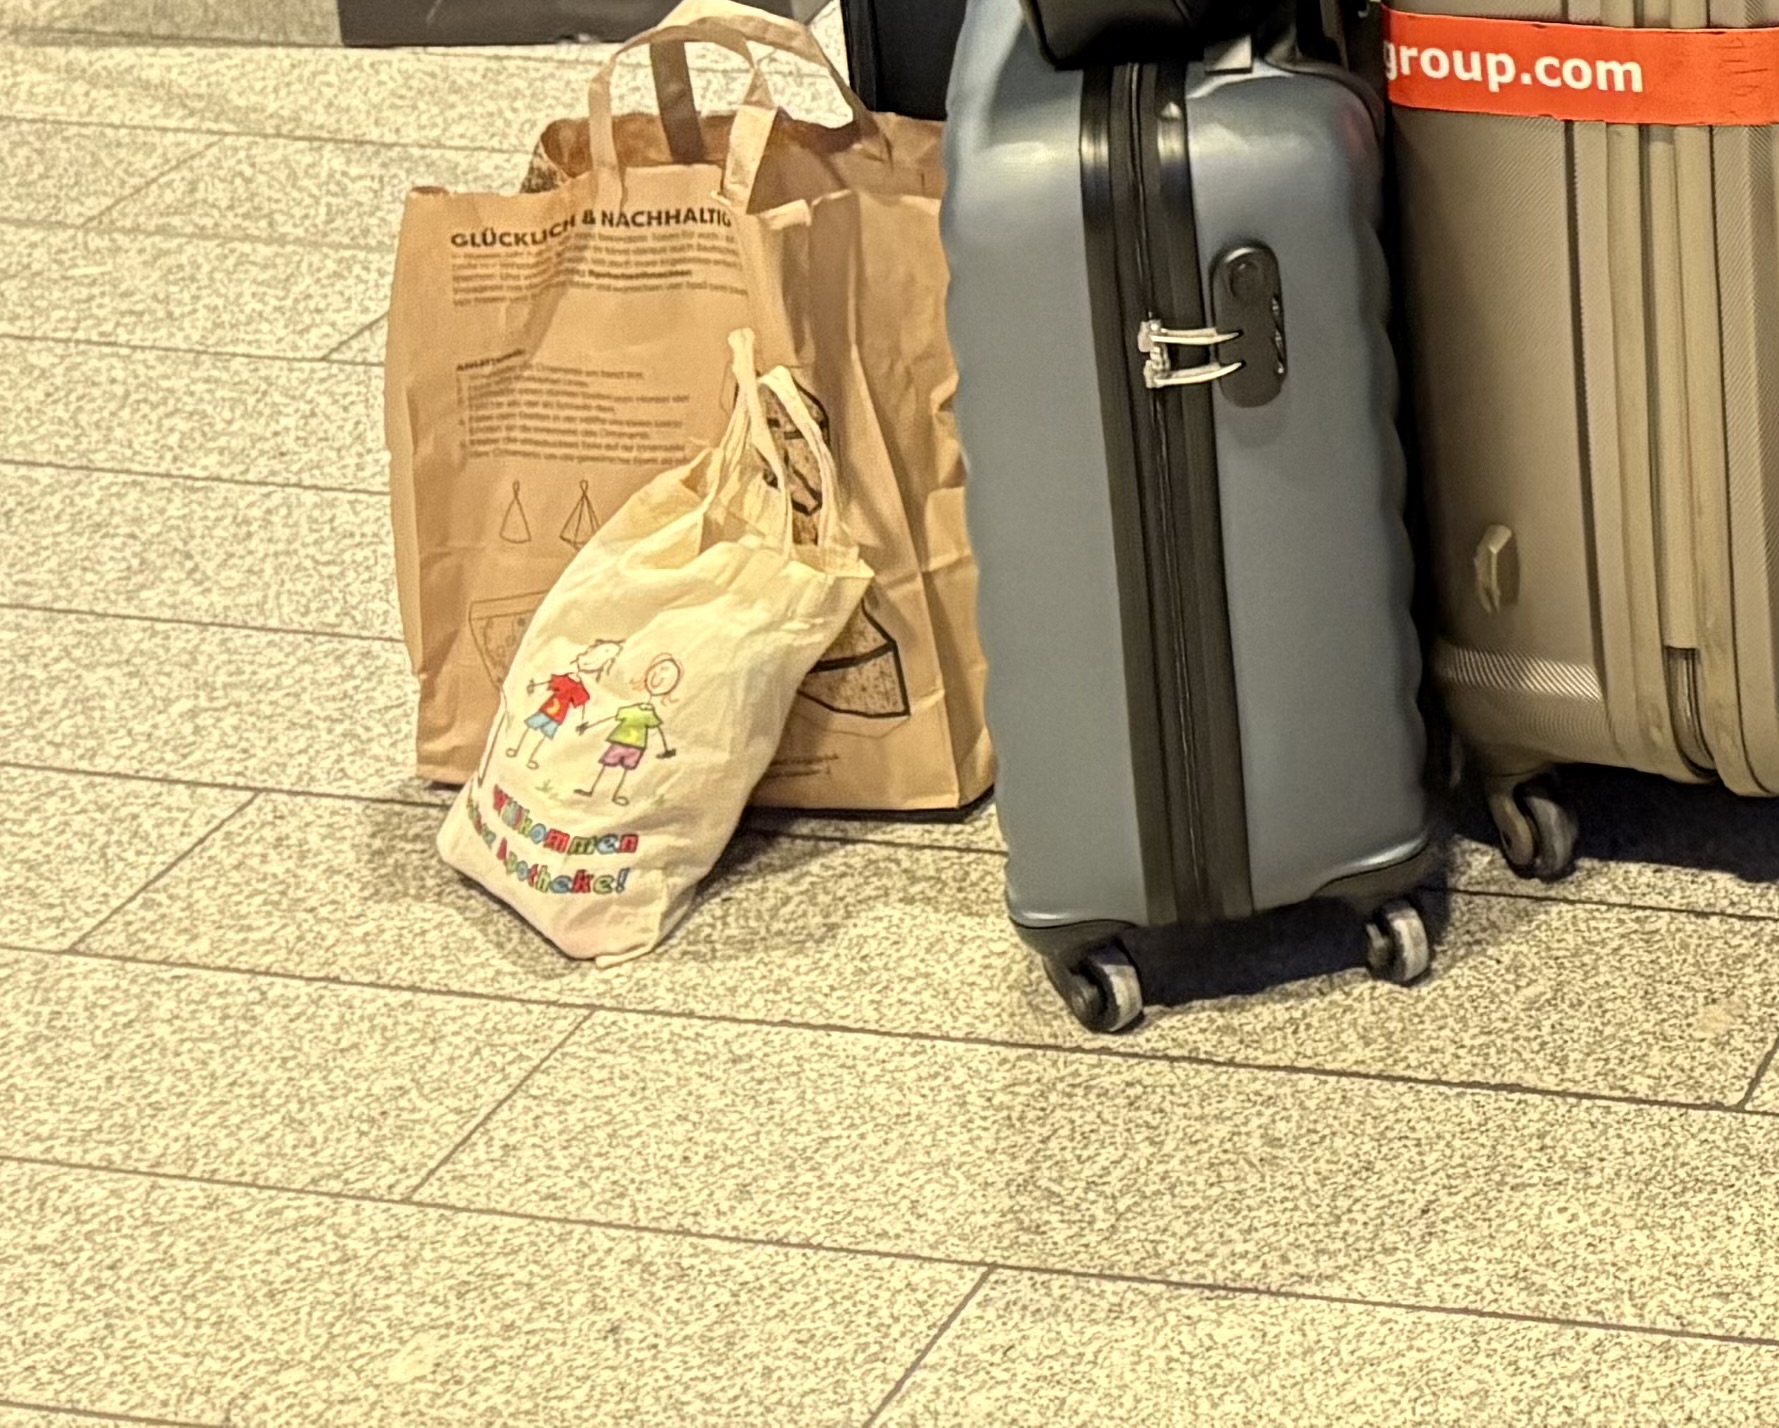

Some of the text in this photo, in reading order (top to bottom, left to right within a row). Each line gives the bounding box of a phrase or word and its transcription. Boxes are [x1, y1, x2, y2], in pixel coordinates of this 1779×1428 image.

[451, 206, 732, 249] GLÜCKLICH & NACHHALTIG
